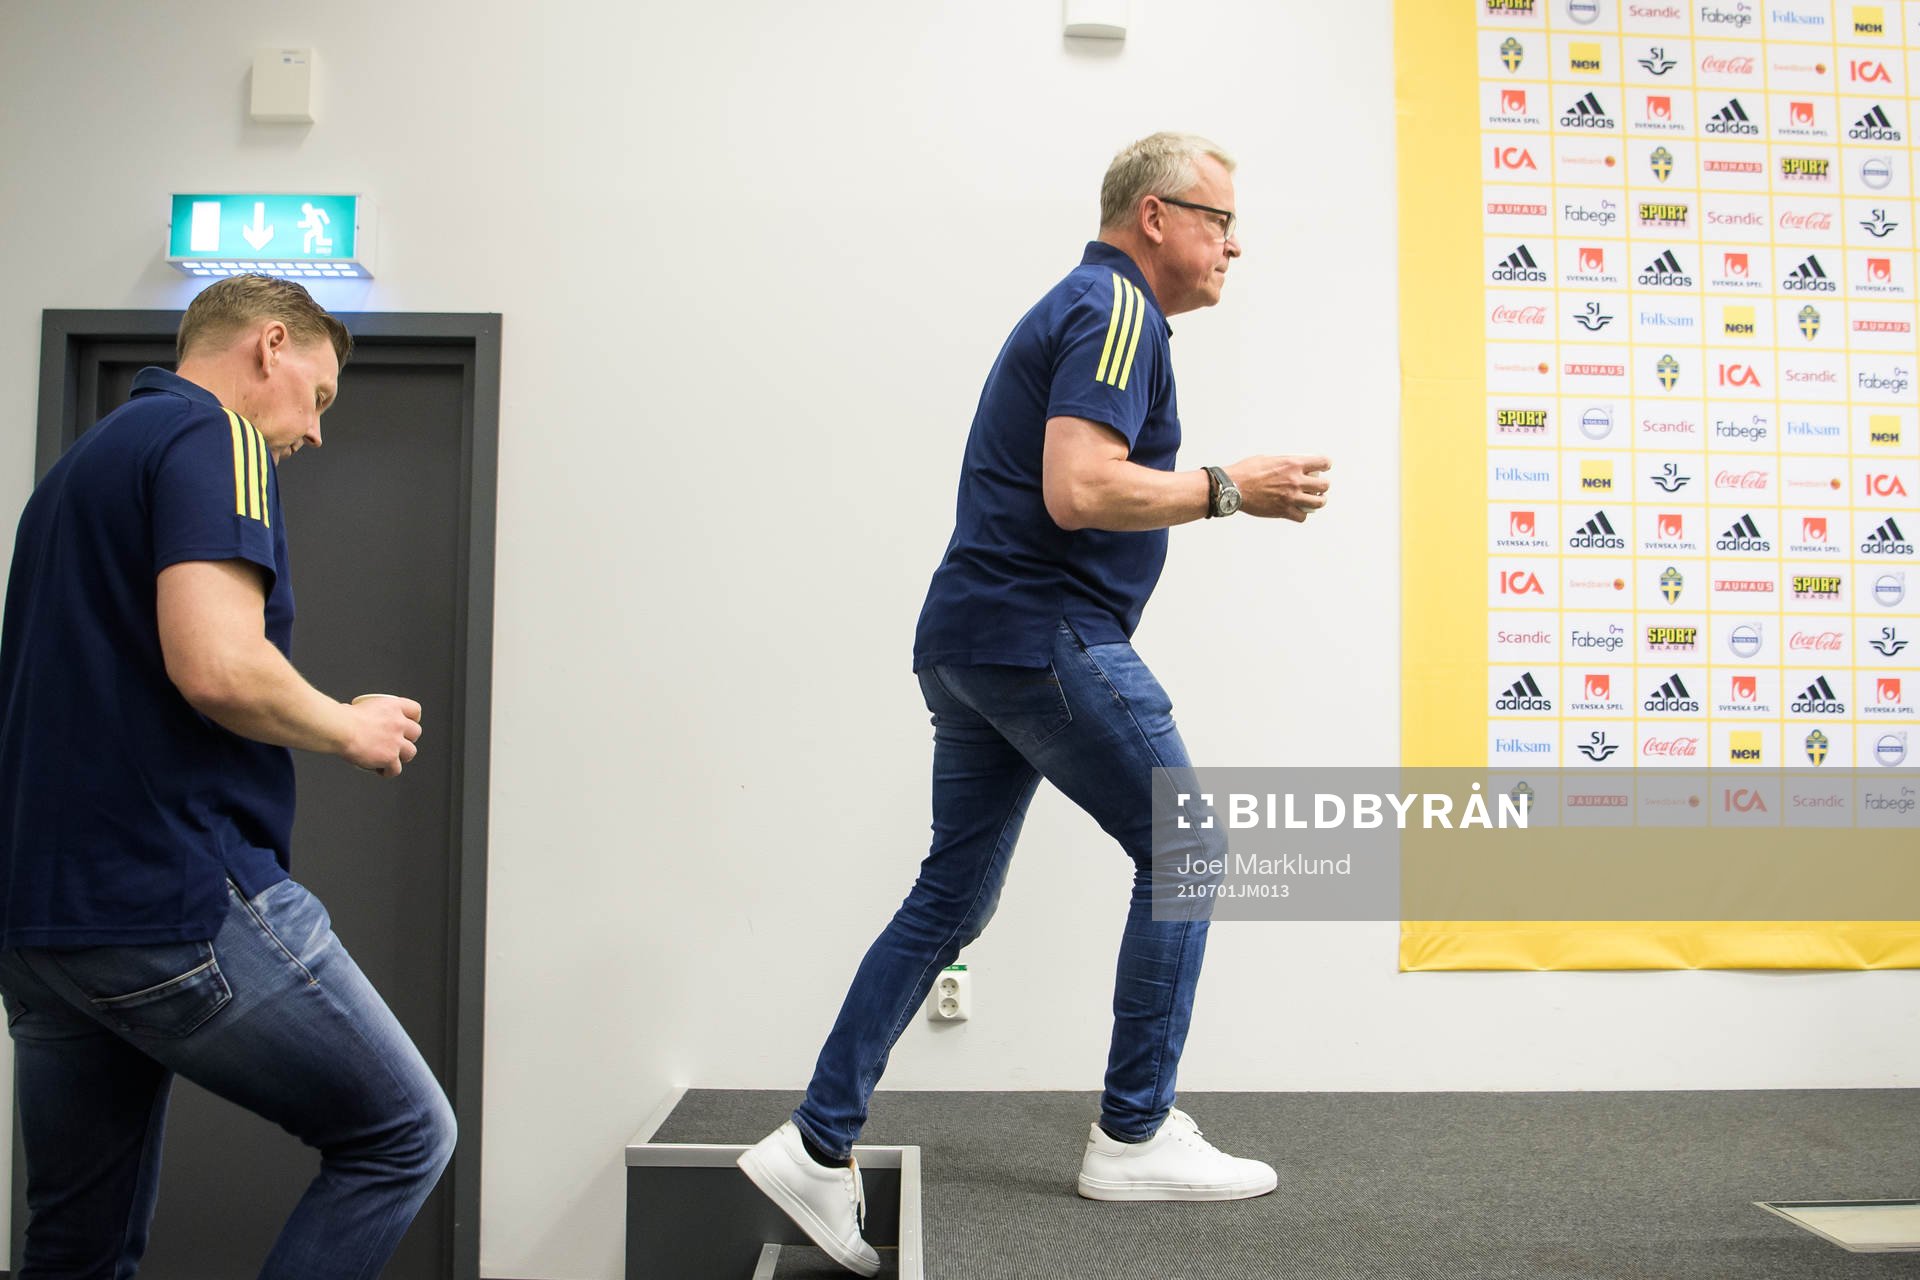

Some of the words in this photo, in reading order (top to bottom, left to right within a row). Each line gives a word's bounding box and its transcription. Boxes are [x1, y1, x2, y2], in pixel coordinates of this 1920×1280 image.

[1629, 5, 1680, 19] Scandic
[1701, 8, 1751, 28] Fabege
[1772, 10, 1824, 25] Folksam
[1650, 47, 1664, 60] SJ
[1850, 61, 1892, 83] ICA
[1560, 114, 1614, 129] adidas
[1705, 121, 1759, 135] adidas
[1848, 127, 1901, 141] adidas
[1494, 147, 1537, 170] ICA
[1781, 158, 1829, 176] SPORT
[1487, 203, 1547, 216] BAUHAUS
[1565, 205, 1616, 226] Fabege
[1639, 204, 1688, 221] SPORT
[1871, 209, 1885, 222] SJ
[1707, 211, 1764, 226] Scandic
[1492, 267, 1546, 282] adidas
[1638, 273, 1692, 287] adidas
[1782, 278, 1836, 292] adidas
[1586, 302, 1600, 315] SJ
[1640, 312, 1694, 327] Folksam
[1853, 321, 1910, 333] BAUHAUS
[1565, 364, 1624, 376] BAUHAUS
[1719, 364, 1761, 387] ICA
[1786, 369, 1837, 383] Scandic
[1858, 373, 1908, 394] Fabege
[1497, 410, 1546, 428] SPORT
[1642, 420, 1695, 433] Scandic
[1716, 421, 1767, 442] Fabege
[1787, 422, 1840, 436] Folksam
[1495, 467, 1550, 482] Folksam
[1664, 463, 1677, 476] SJ
[1866, 474, 1907, 497] ICA
[1569, 535, 1624, 549] adidas
[1716, 537, 1770, 551] adidas
[1861, 540, 1914, 555] adidas
[1501, 571, 1544, 594] ICA
[1715, 581, 1773, 592] BAUHAUS
[1792, 576, 1841, 594] SPORT
[1498, 631, 1551, 644] Scandic
[1648, 627, 1696, 645] SPORT
[1882, 627, 1896, 640] SJ
[1572, 631, 1623, 652] Fabege
[1496, 697, 1551, 711] adidas
[1645, 698, 1699, 712] adidas
[1791, 700, 1845, 714] adidas
[1591, 731, 1605, 744] SJ
[1496, 739, 1551, 753] Folksam
[1568, 796, 1627, 806] BAUHAUS
[1724, 788, 1767, 812] ICA
[1793, 795, 1845, 808] Scandic
[1865, 793, 1915, 813] Fabege
